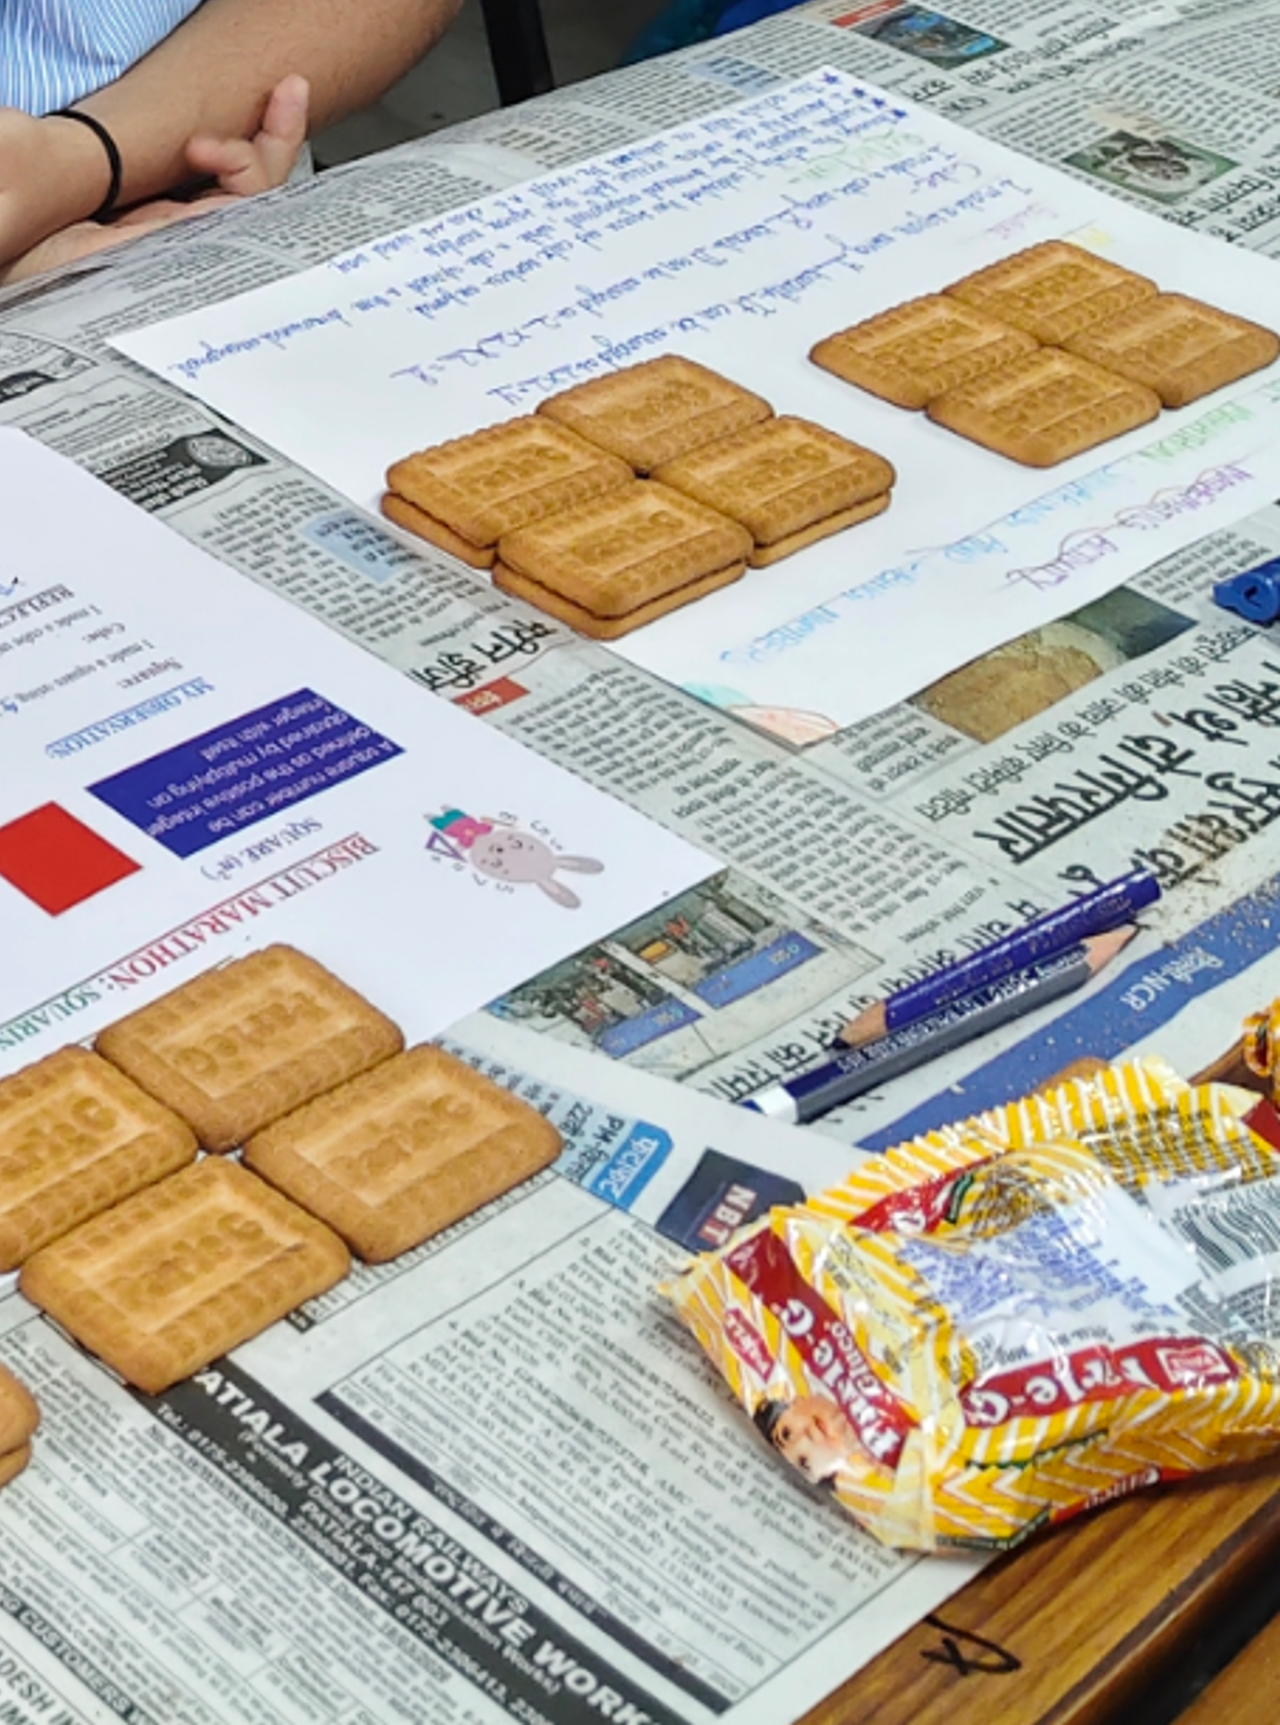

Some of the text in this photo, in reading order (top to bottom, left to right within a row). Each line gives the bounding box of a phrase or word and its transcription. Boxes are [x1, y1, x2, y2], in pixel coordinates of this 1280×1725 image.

[80, 621, 127, 645] Cube:
[115, 655, 185, 690] Square:
[142, 708, 349, 812] obtained by multiplying an
[198, 696, 333, 763] integer with itself
[1114, 728, 1206, 782] दो
[144, 724, 372, 838] defined as the positive integer
[203, 737, 397, 838] A square number can be
[238, 816, 324, 864] SQUARE
[264, 831, 381, 899] BISCUIT
[92, 893, 273, 992] MARATHON:
[699, 1183, 758, 1255] NBT
[192, 1365, 664, 1725] ATIALA LOCOMOTIVE WORK
[296, 1499, 455, 1632] PATIALA-147 003
[328, 1450, 535, 1621] INDIAN RAILWAYS
[15, 1607, 141, 1716] CUSTOMERS
